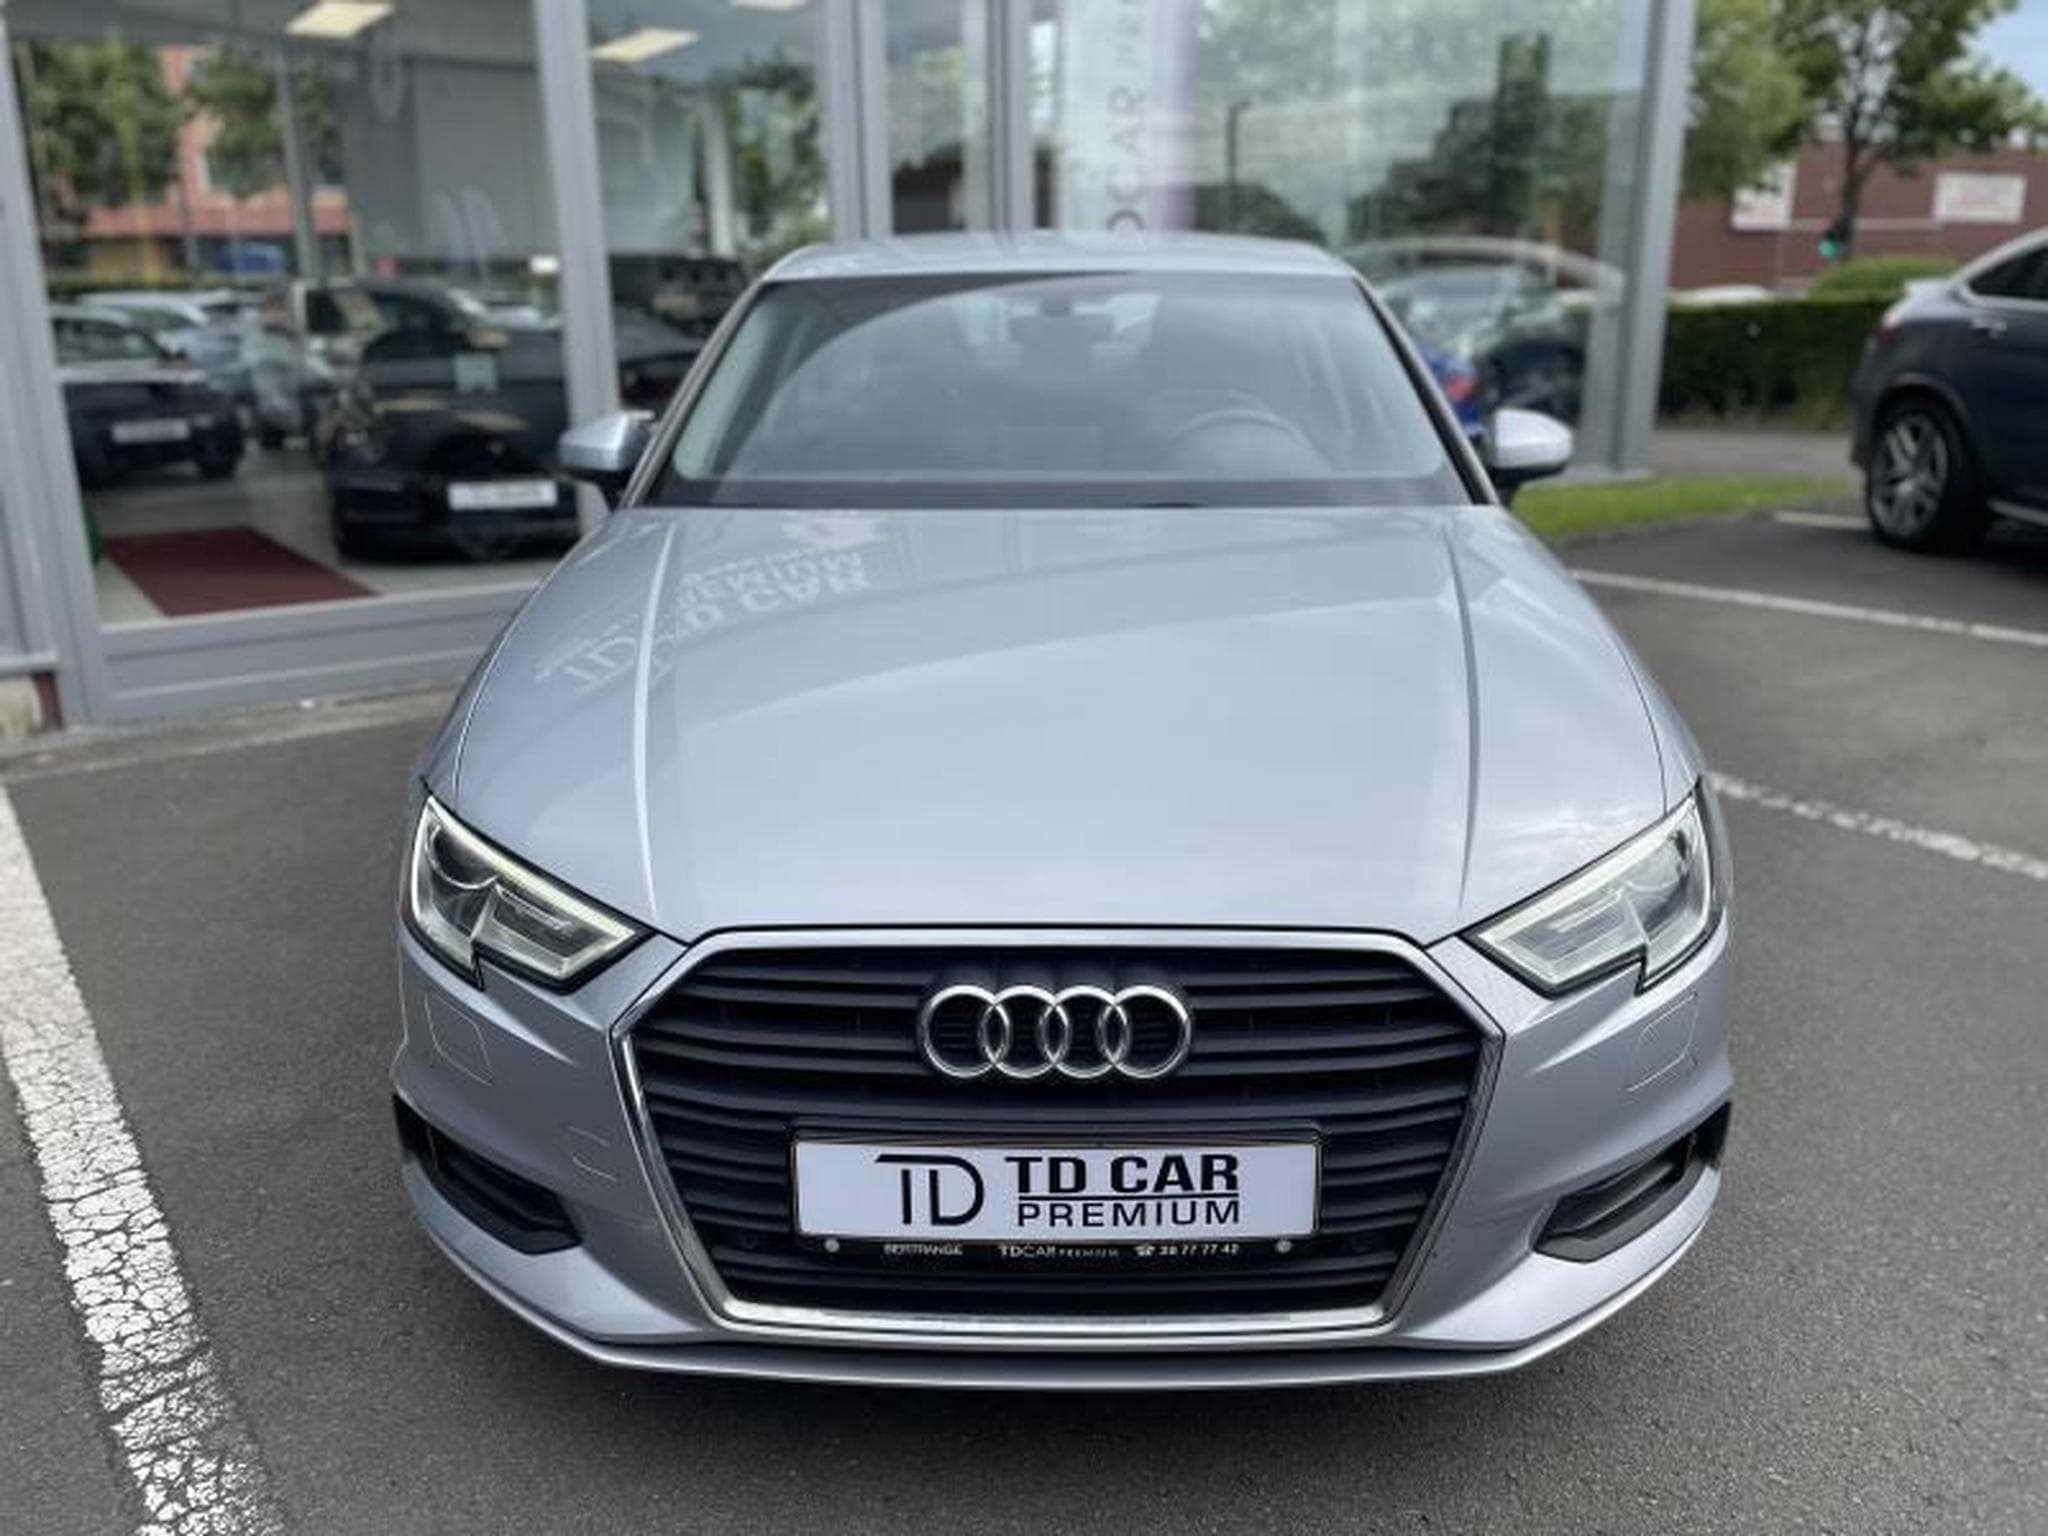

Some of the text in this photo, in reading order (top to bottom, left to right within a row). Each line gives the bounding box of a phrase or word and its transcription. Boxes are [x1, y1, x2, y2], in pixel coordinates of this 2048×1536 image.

[875, 1154, 985, 1226] TD
[1004, 1154, 1239, 1194] TD CAR
[1017, 1200, 1239, 1227] PREMIUM
